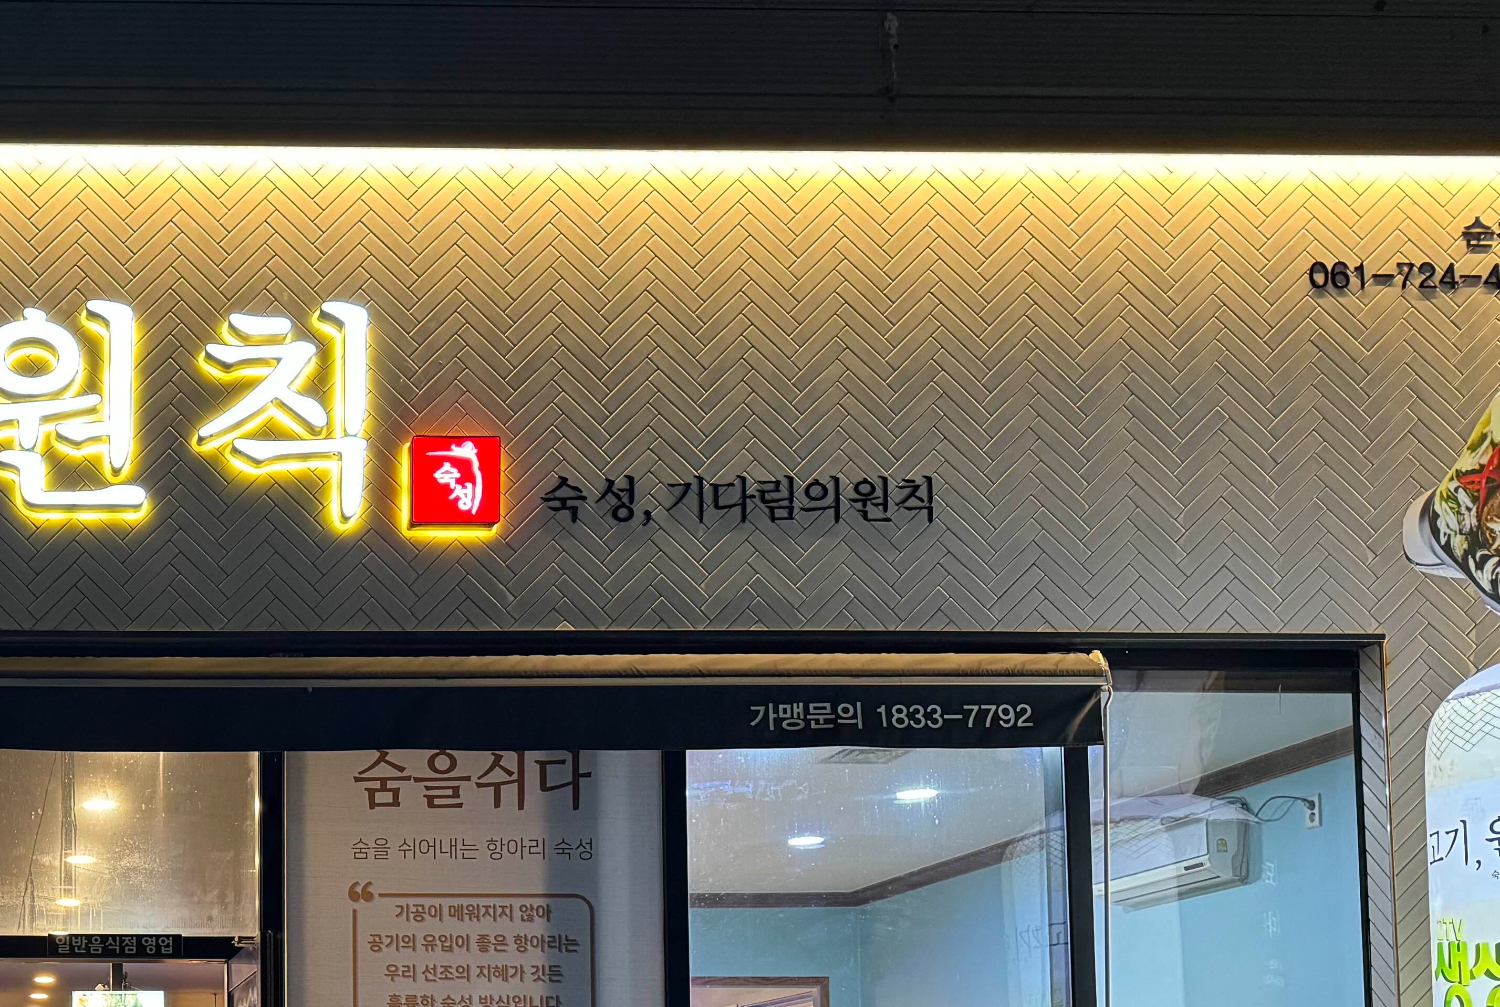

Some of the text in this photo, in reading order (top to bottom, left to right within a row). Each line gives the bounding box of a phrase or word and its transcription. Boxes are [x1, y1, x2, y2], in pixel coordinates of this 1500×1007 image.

[749, 702, 1034, 731] 가맹문의 1833-7792
[350, 837, 594, 861] 숨을 쉬어내는 항아리 숙성
[394, 903, 552, 922] 기공이 메워지지 않아
[55, 936, 173, 954] 일반음식점 영업
[367, 934, 580, 953] 공기의 유입이 좋은 항아리는
[384, 963, 564, 983] 우리 선조의 지혜가 깃든
